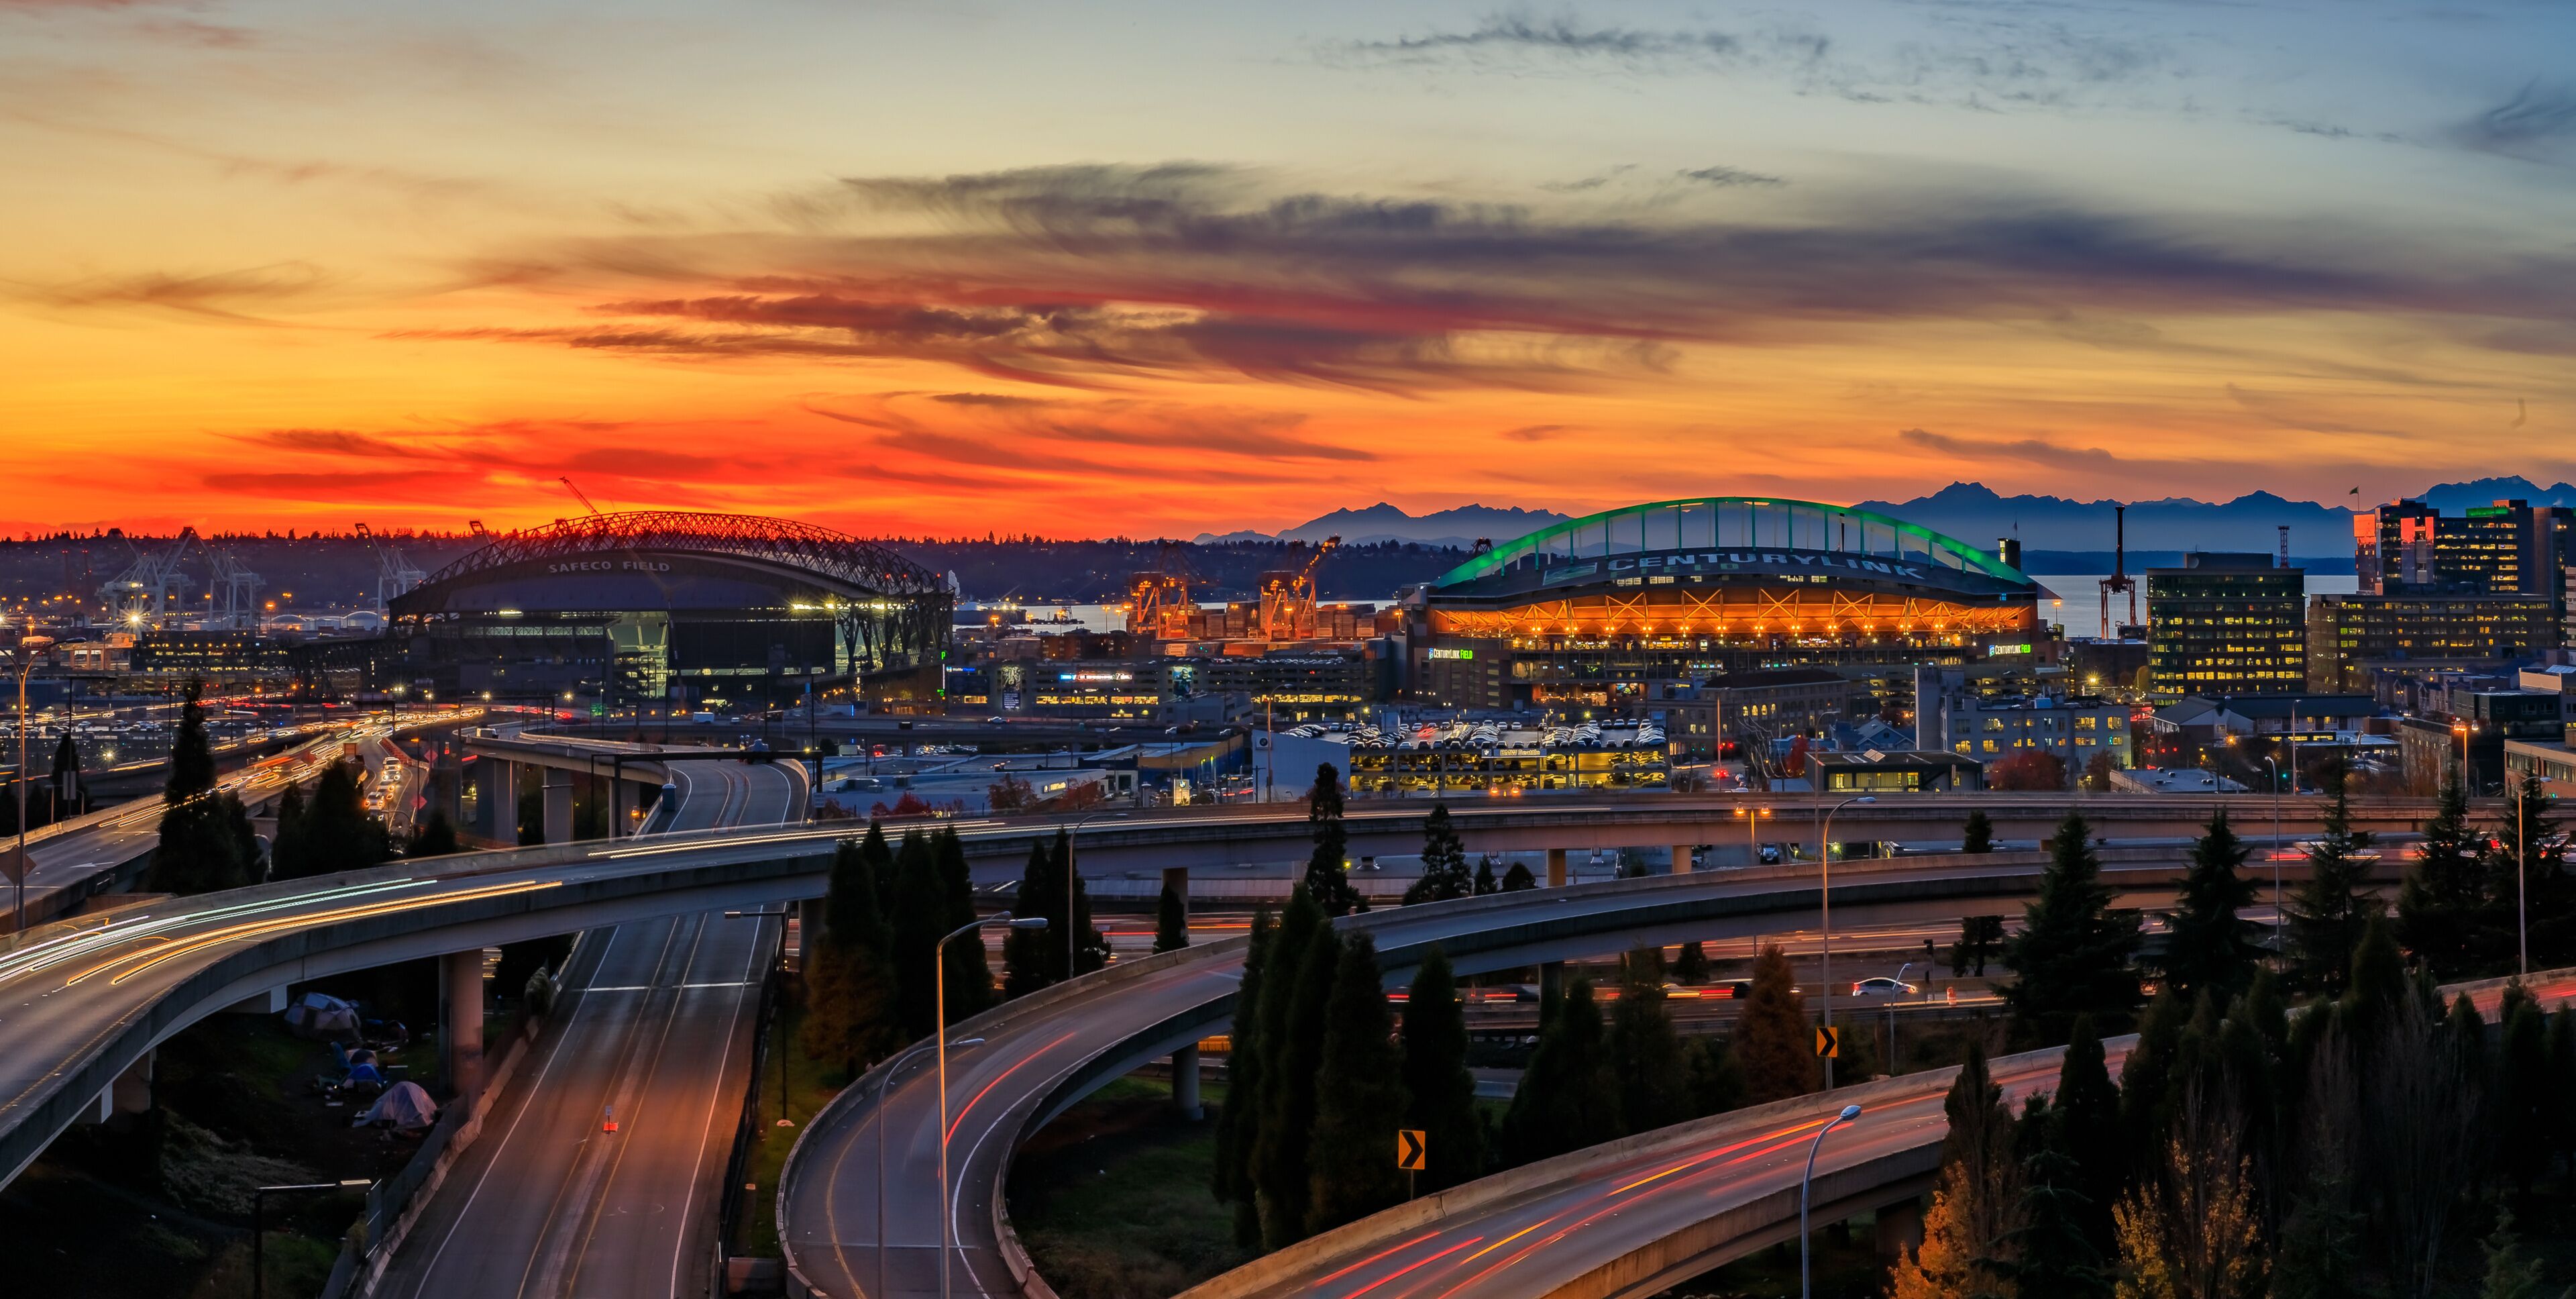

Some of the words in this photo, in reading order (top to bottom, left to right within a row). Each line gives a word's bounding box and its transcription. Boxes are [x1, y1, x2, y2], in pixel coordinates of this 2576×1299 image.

[549, 561, 612, 573] SAFECO
[623, 561, 670, 571] FIELD
[1608, 553, 1925, 580] CENTURYLINK
[1460, 649, 1473, 660] FIELD
